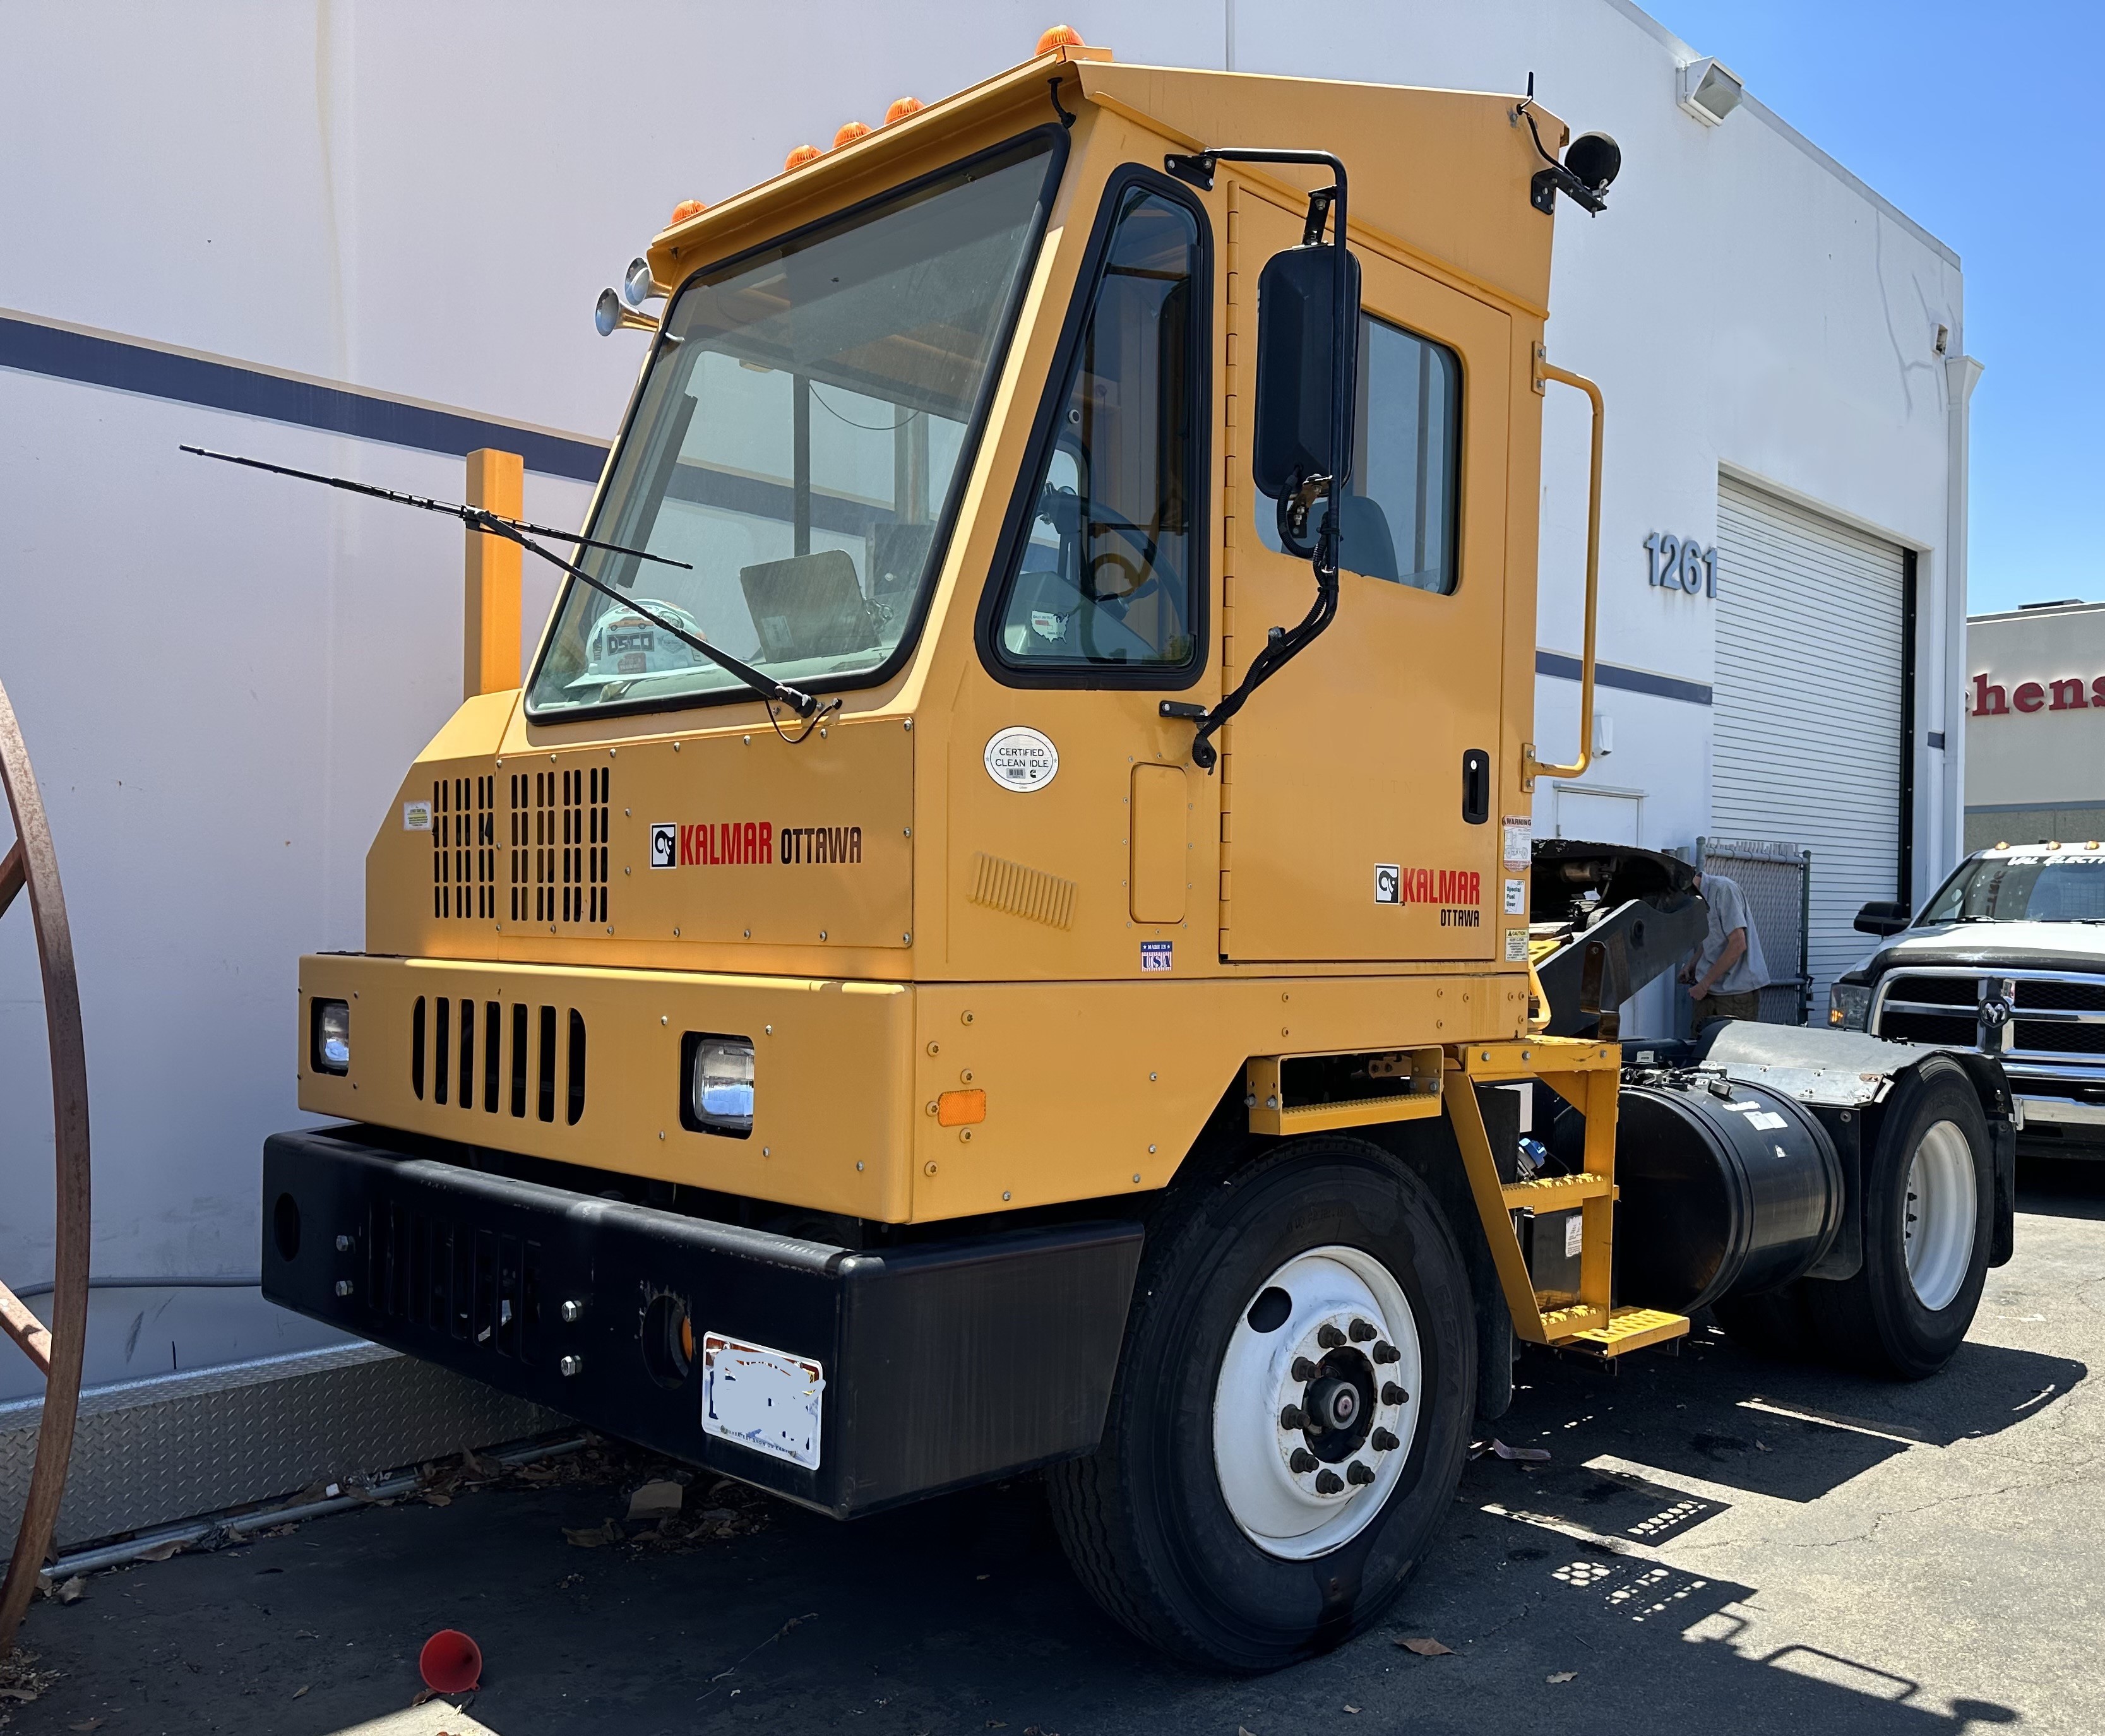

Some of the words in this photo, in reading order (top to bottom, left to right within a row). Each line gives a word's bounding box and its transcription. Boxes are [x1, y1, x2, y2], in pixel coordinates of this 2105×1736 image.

[1643, 532, 1717, 598] 1261
[1965, 673, 2105, 716] hens
[999, 748, 1044, 756] CERTIFIED
[681, 822, 772, 865] KALMAR
[781, 826, 862, 864] OTTAWA
[1403, 867, 1480, 905] KALMAR
[1440, 909, 1479, 927] OTTAWA
[1143, 956, 1171, 968] USA
